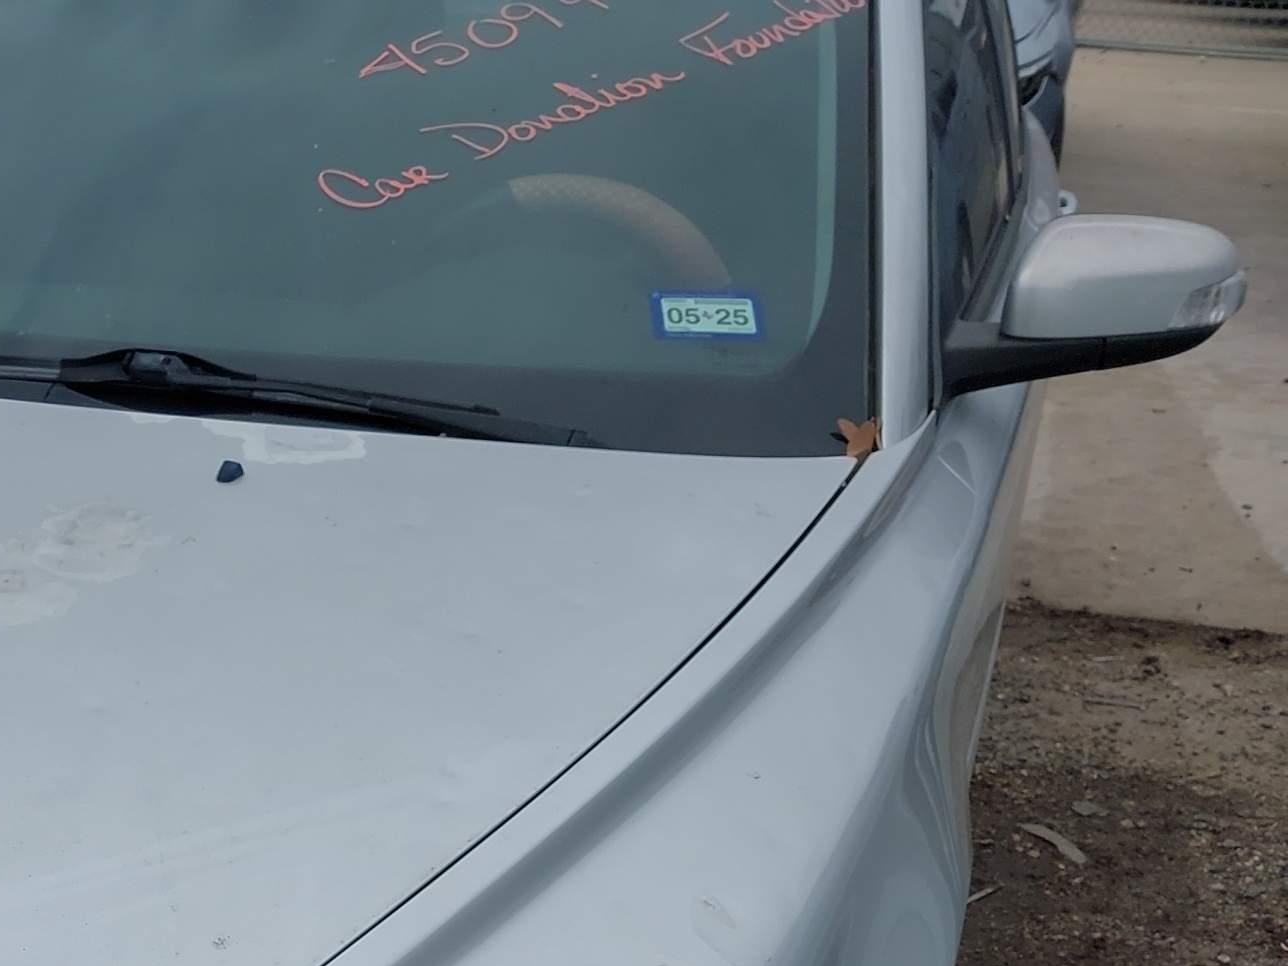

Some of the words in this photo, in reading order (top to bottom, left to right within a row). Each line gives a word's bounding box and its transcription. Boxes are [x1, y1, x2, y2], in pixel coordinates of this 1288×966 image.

[318, 165, 449, 208] Car
[420, 71, 686, 160] Donation
[667, 307, 700, 325] 05
[715, 308, 749, 326] 25
